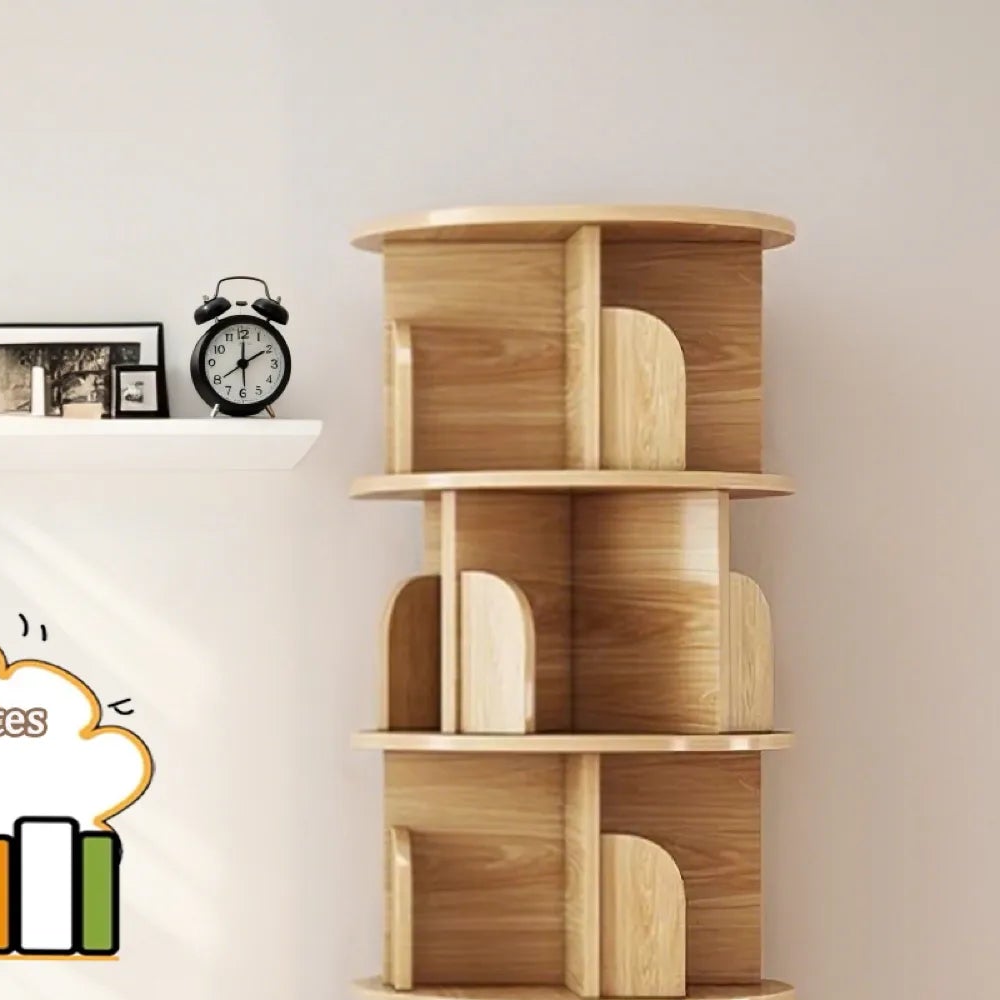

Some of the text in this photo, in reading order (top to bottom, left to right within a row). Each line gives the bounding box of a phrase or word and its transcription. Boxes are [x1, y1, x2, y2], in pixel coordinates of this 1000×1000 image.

[237, 328, 249, 340] 12
[214, 344, 225, 354] 10
[265, 344, 273, 354] 2
[270, 358, 279, 369] 3
[213, 374, 222, 385] 8
[265, 374, 272, 384] 4
[224, 385, 232, 395] 7
[239, 388, 247, 398] 6
[255, 385, 263, 396] 5
